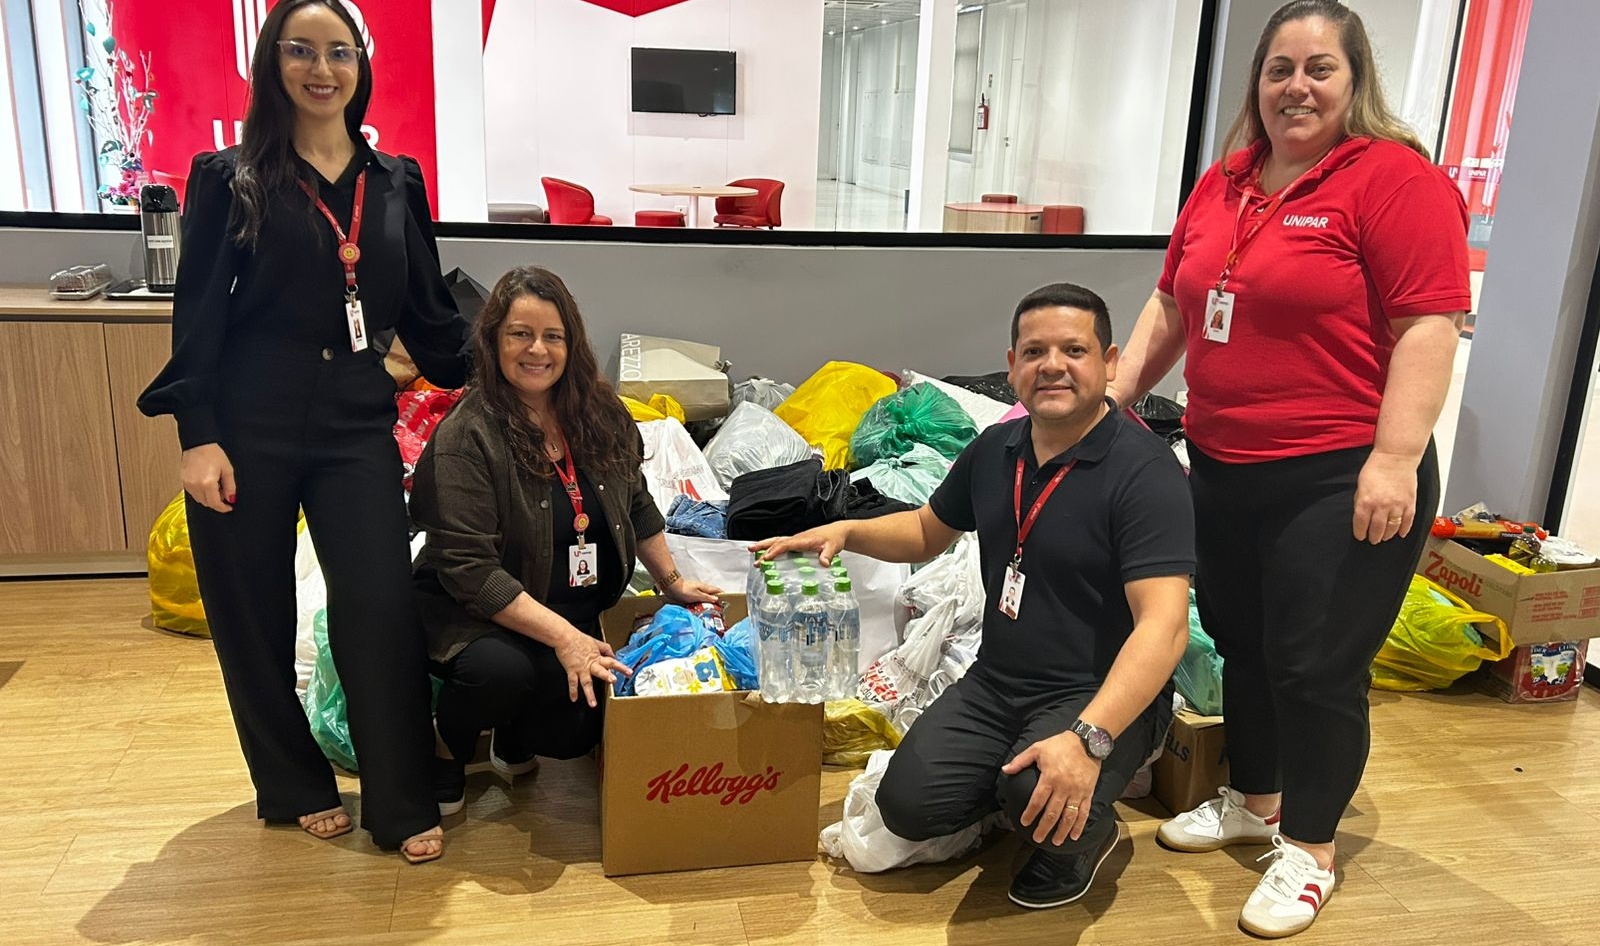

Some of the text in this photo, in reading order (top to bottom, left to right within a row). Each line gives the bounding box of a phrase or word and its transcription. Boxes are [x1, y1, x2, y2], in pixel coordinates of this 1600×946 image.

[1282, 214, 1329, 228] UNIPAR
[620, 333, 641, 381] AREZZO
[1424, 551, 1483, 598] Zapoli
[646, 761, 783, 806] Kellogg's
